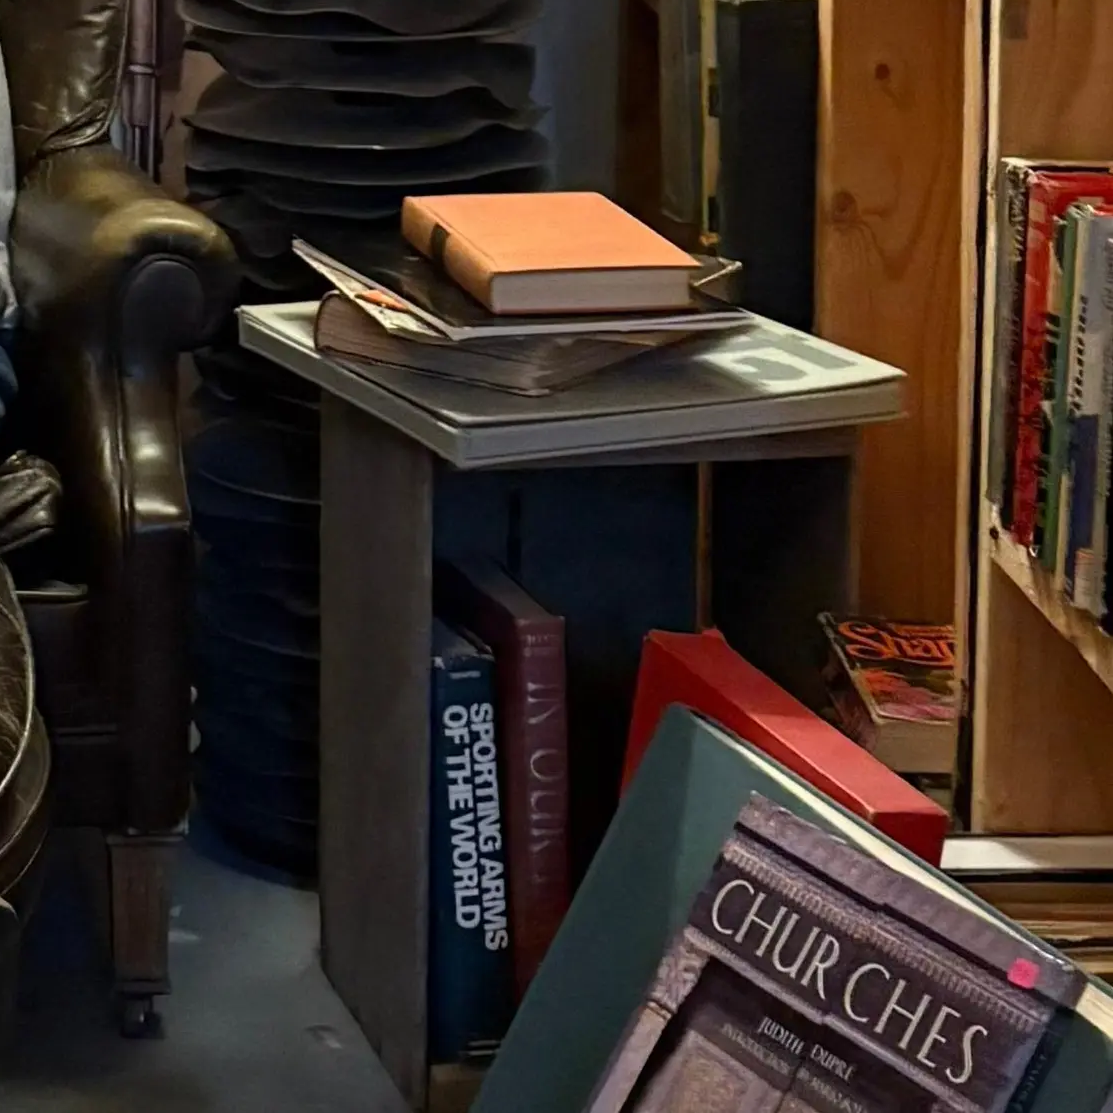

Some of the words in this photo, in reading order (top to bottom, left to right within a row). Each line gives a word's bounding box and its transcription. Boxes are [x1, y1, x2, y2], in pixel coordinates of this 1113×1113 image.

[442, 704, 470, 744] OF
[526, 681, 561, 724] IN
[445, 752, 474, 811] THE
[469, 702, 502, 852] SPORTING
[449, 812, 482, 929] WORLD
[479, 857, 508, 951] ARMS
[711, 878, 988, 1085] CHURCHES
[757, 1016, 806, 1055] JUDITH
